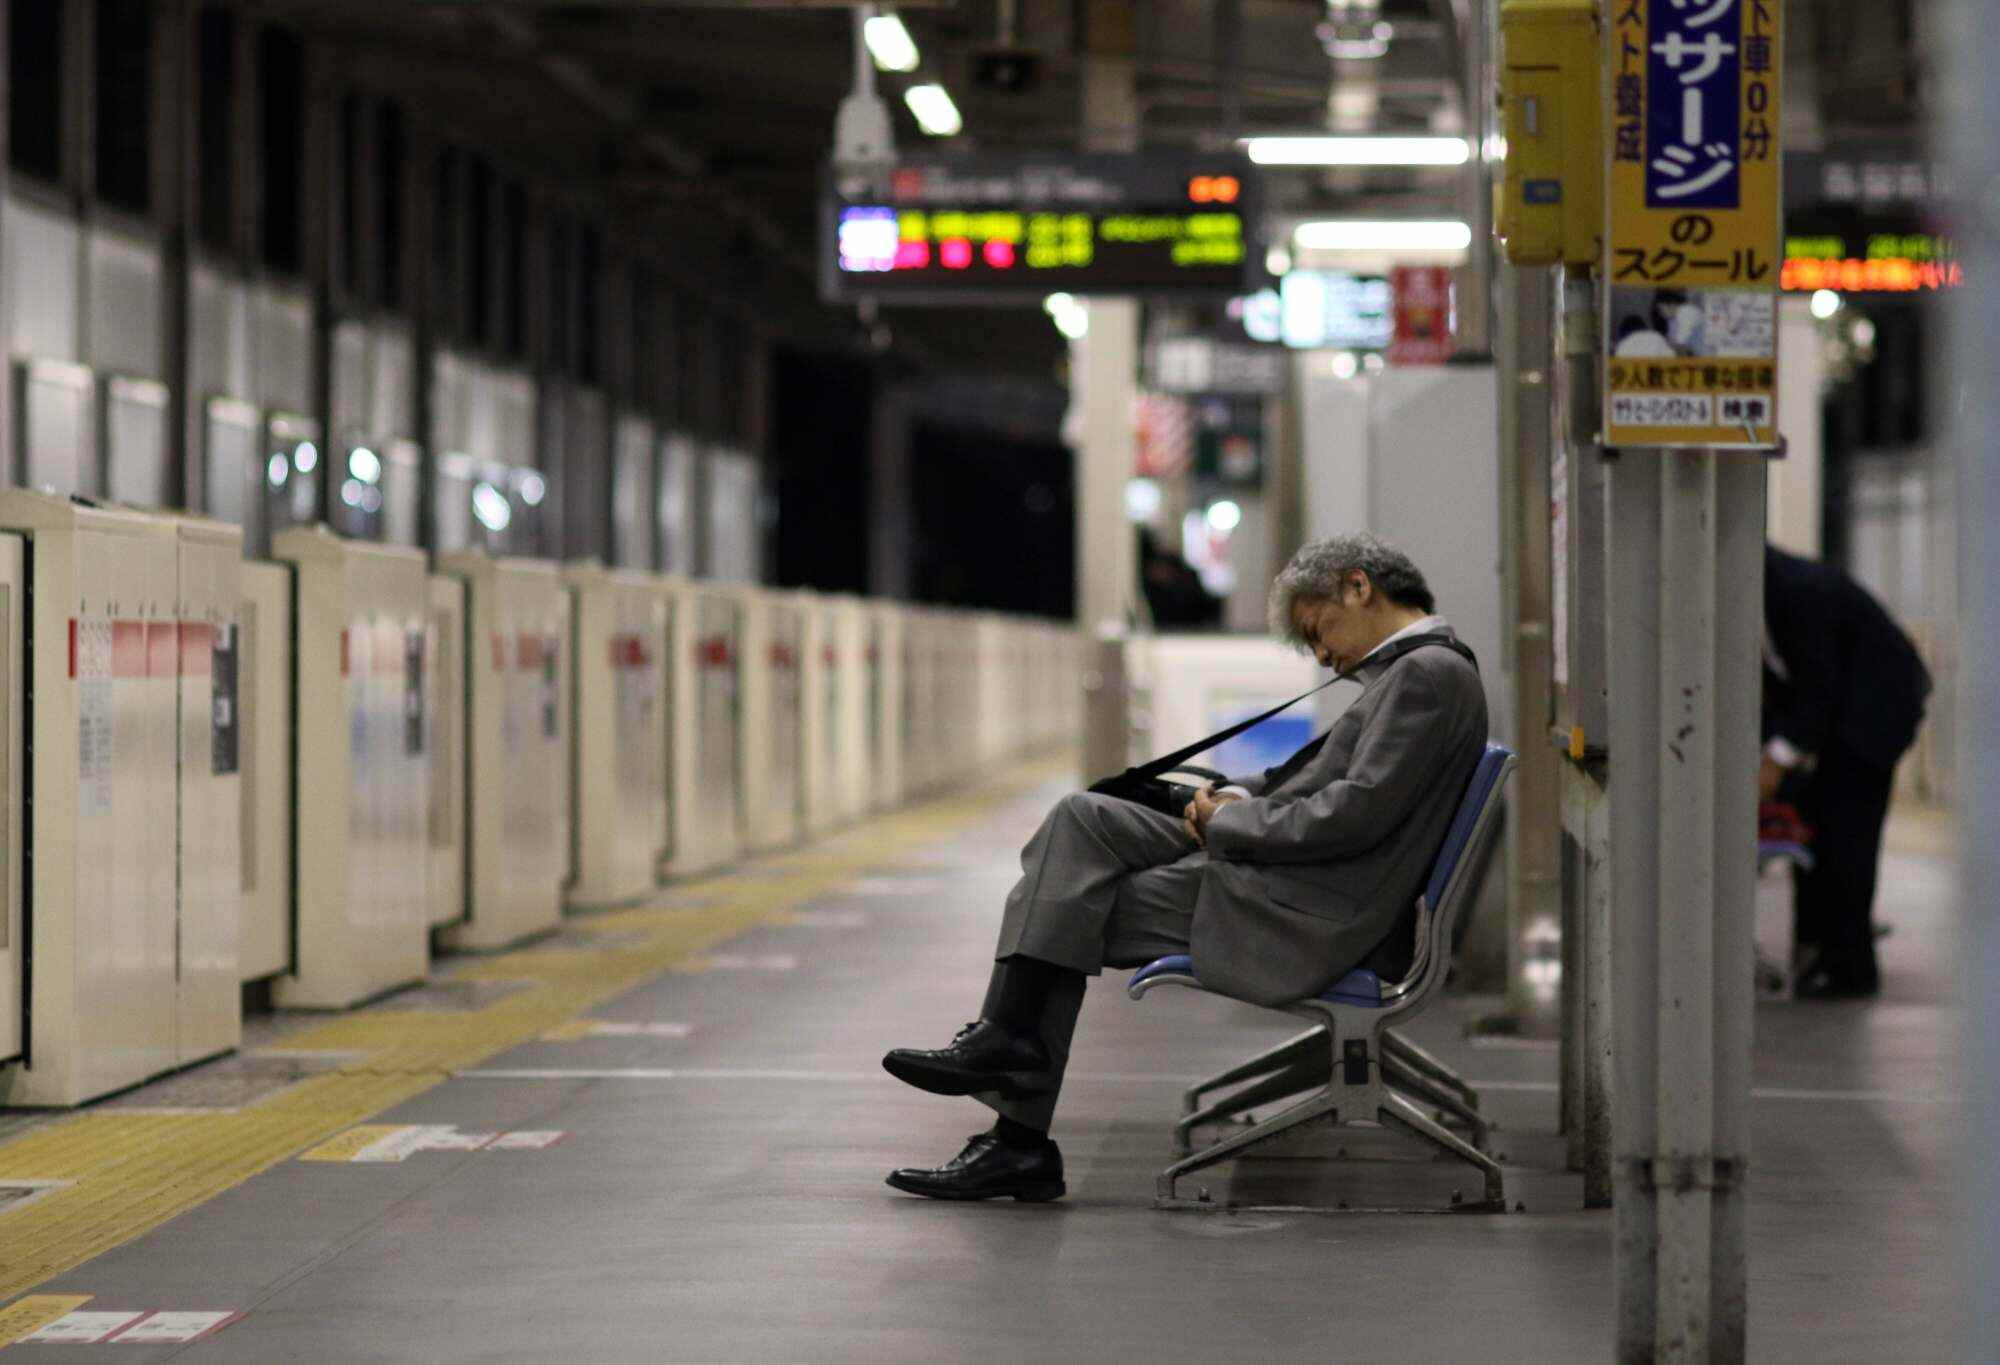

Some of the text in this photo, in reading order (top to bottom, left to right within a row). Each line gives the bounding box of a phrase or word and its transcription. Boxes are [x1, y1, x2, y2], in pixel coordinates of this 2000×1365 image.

[1671, 213, 1714, 245] の
[1613, 248, 1769, 281] スクール
